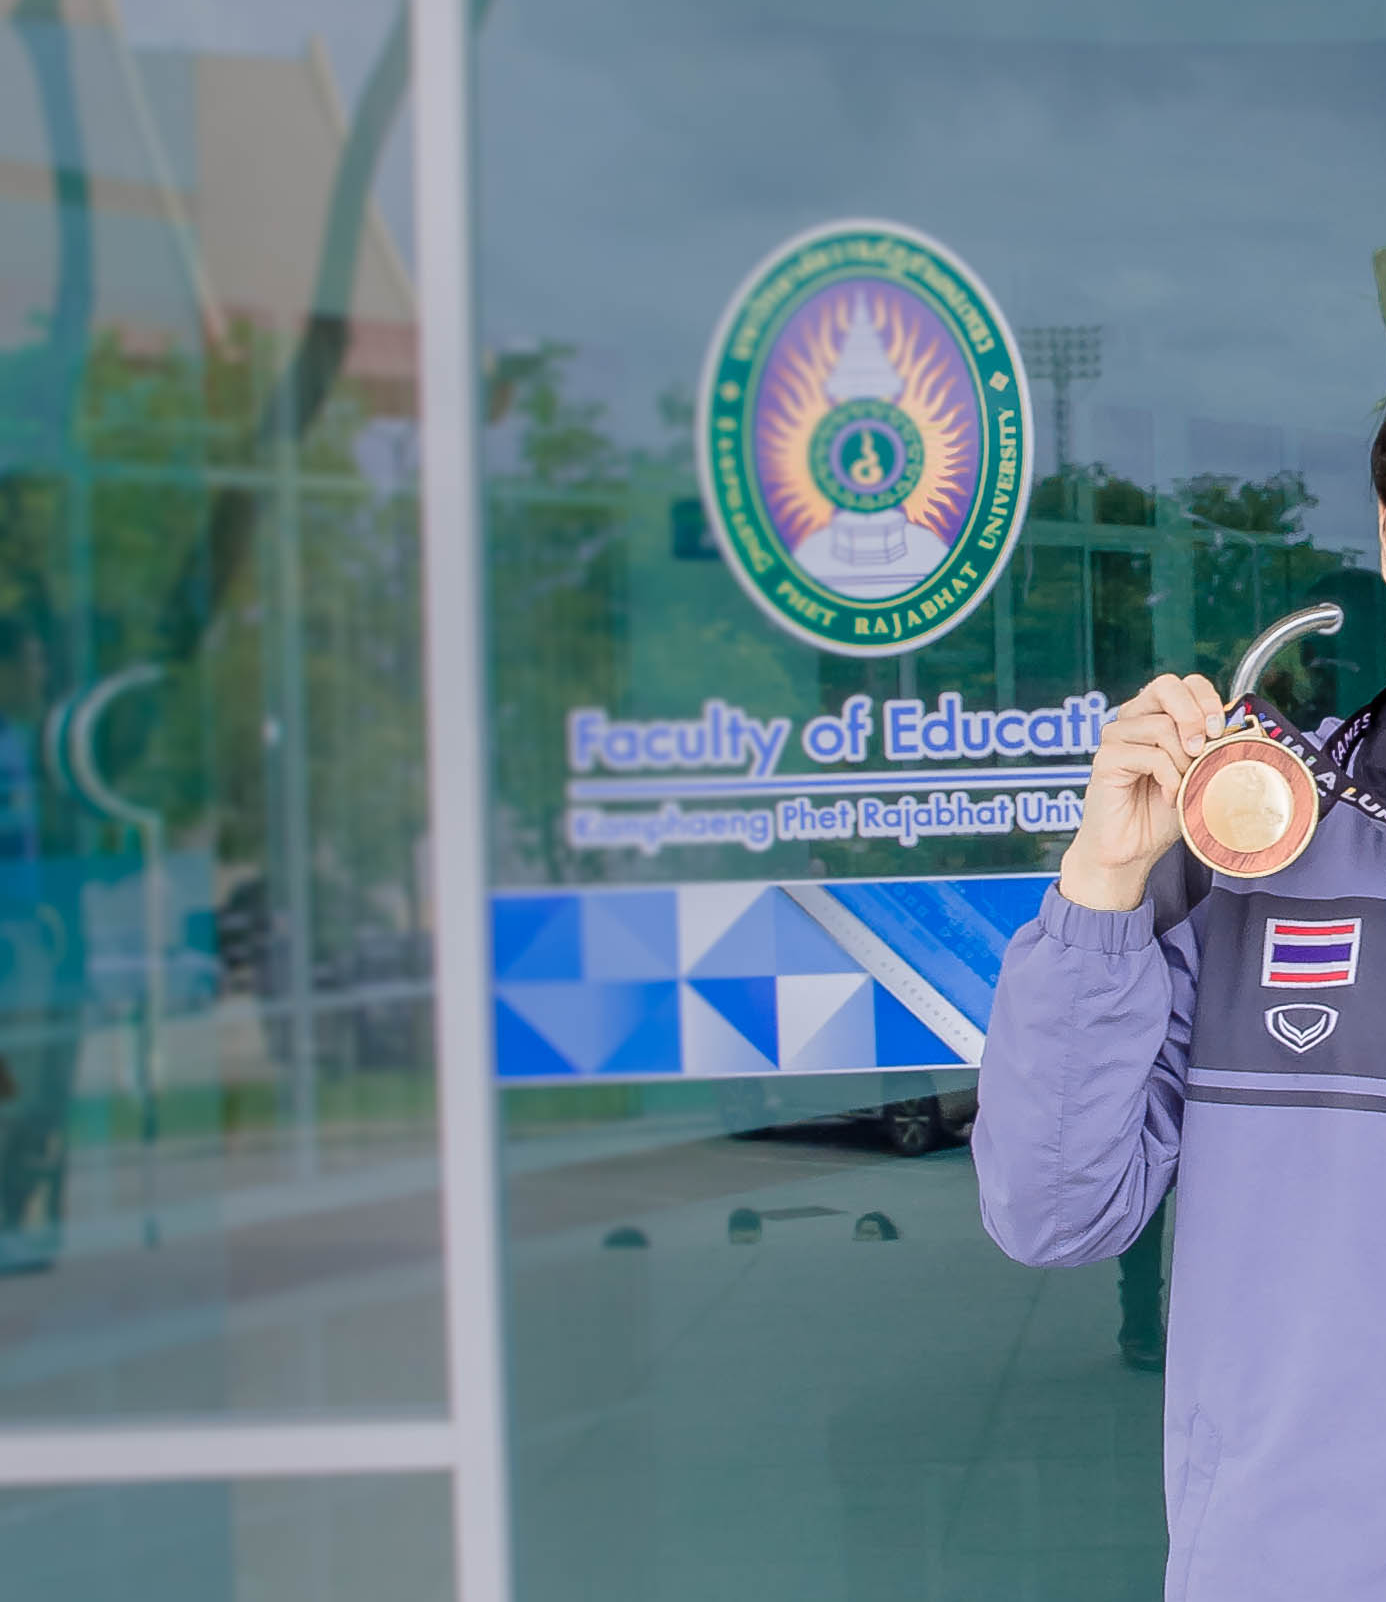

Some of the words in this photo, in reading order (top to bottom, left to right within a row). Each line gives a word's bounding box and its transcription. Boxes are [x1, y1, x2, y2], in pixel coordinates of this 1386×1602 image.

[854, 561, 980, 638] RAJABHAT
[978, 406, 1017, 550] UNIVERSITY
[573, 702, 787, 778] Faculty
[808, 699, 871, 760] of
[887, 694, 1119, 756] Educati
[782, 798, 850, 832] Phet
[864, 794, 1011, 839] Rajabhat
